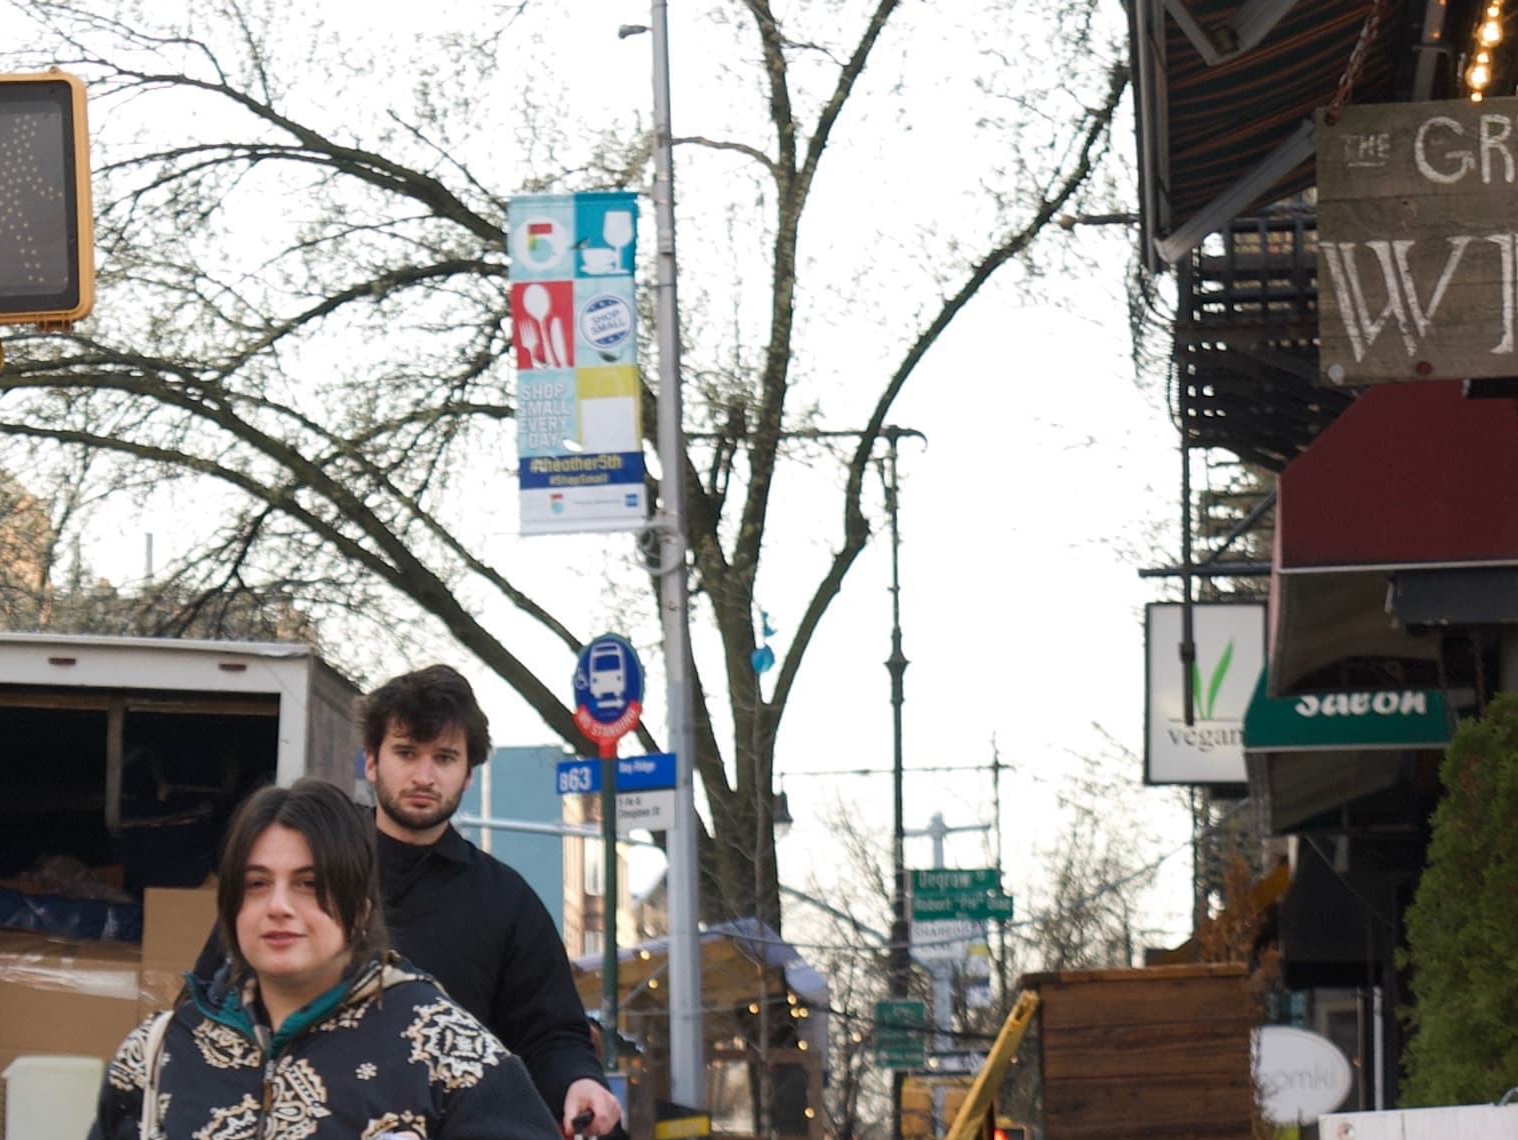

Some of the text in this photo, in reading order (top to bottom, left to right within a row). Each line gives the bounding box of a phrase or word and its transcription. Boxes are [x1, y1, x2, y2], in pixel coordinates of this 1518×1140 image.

[1343, 114, 1515, 184] THE GR
[591, 309, 620, 325] SHOP
[591, 319, 627, 336] SMALL
[521, 383, 565, 401] SHOP
[517, 400, 570, 417] SMALL
[518, 416, 569, 433] EVERY
[528, 432, 561, 449] DAY
[591, 707, 636, 737] STANDING
[559, 766, 592, 791] B63
